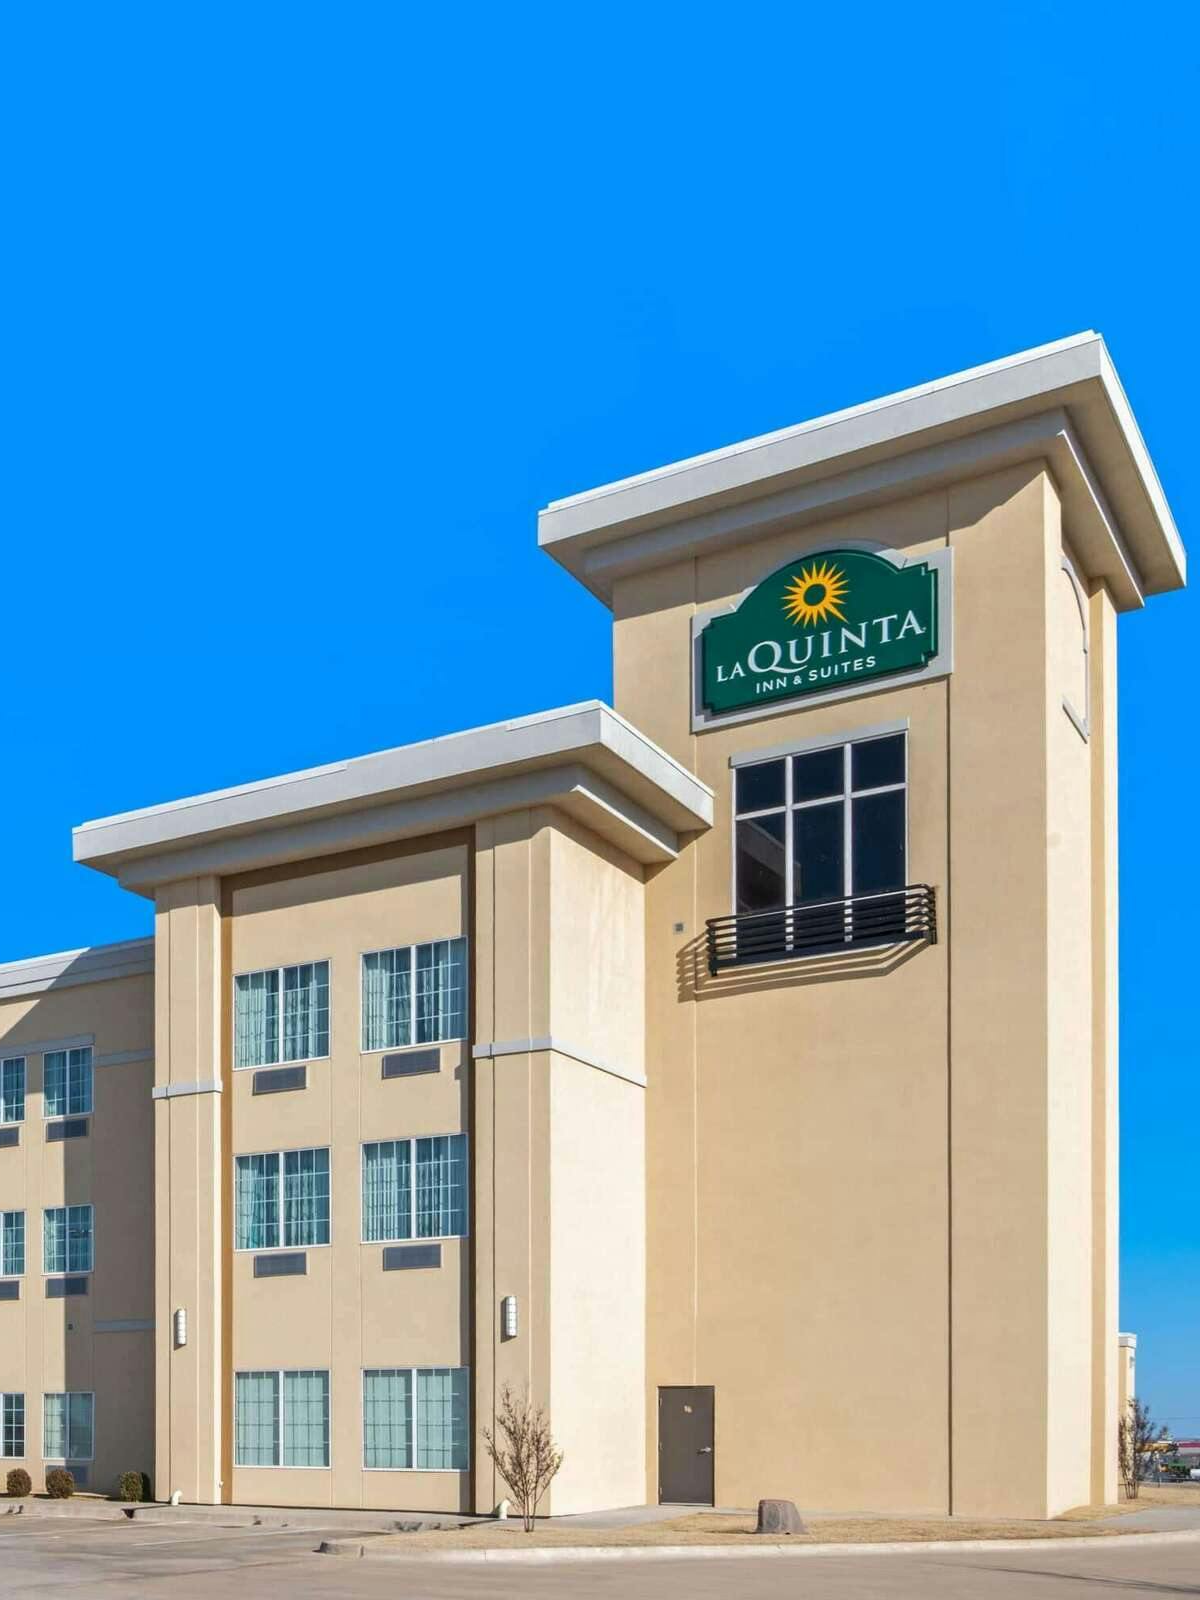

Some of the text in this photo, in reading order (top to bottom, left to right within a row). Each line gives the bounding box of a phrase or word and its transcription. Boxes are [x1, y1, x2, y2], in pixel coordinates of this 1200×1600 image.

[716, 609, 926, 683] LA QUINTA
[755, 655, 877, 694] INN & SUITES
